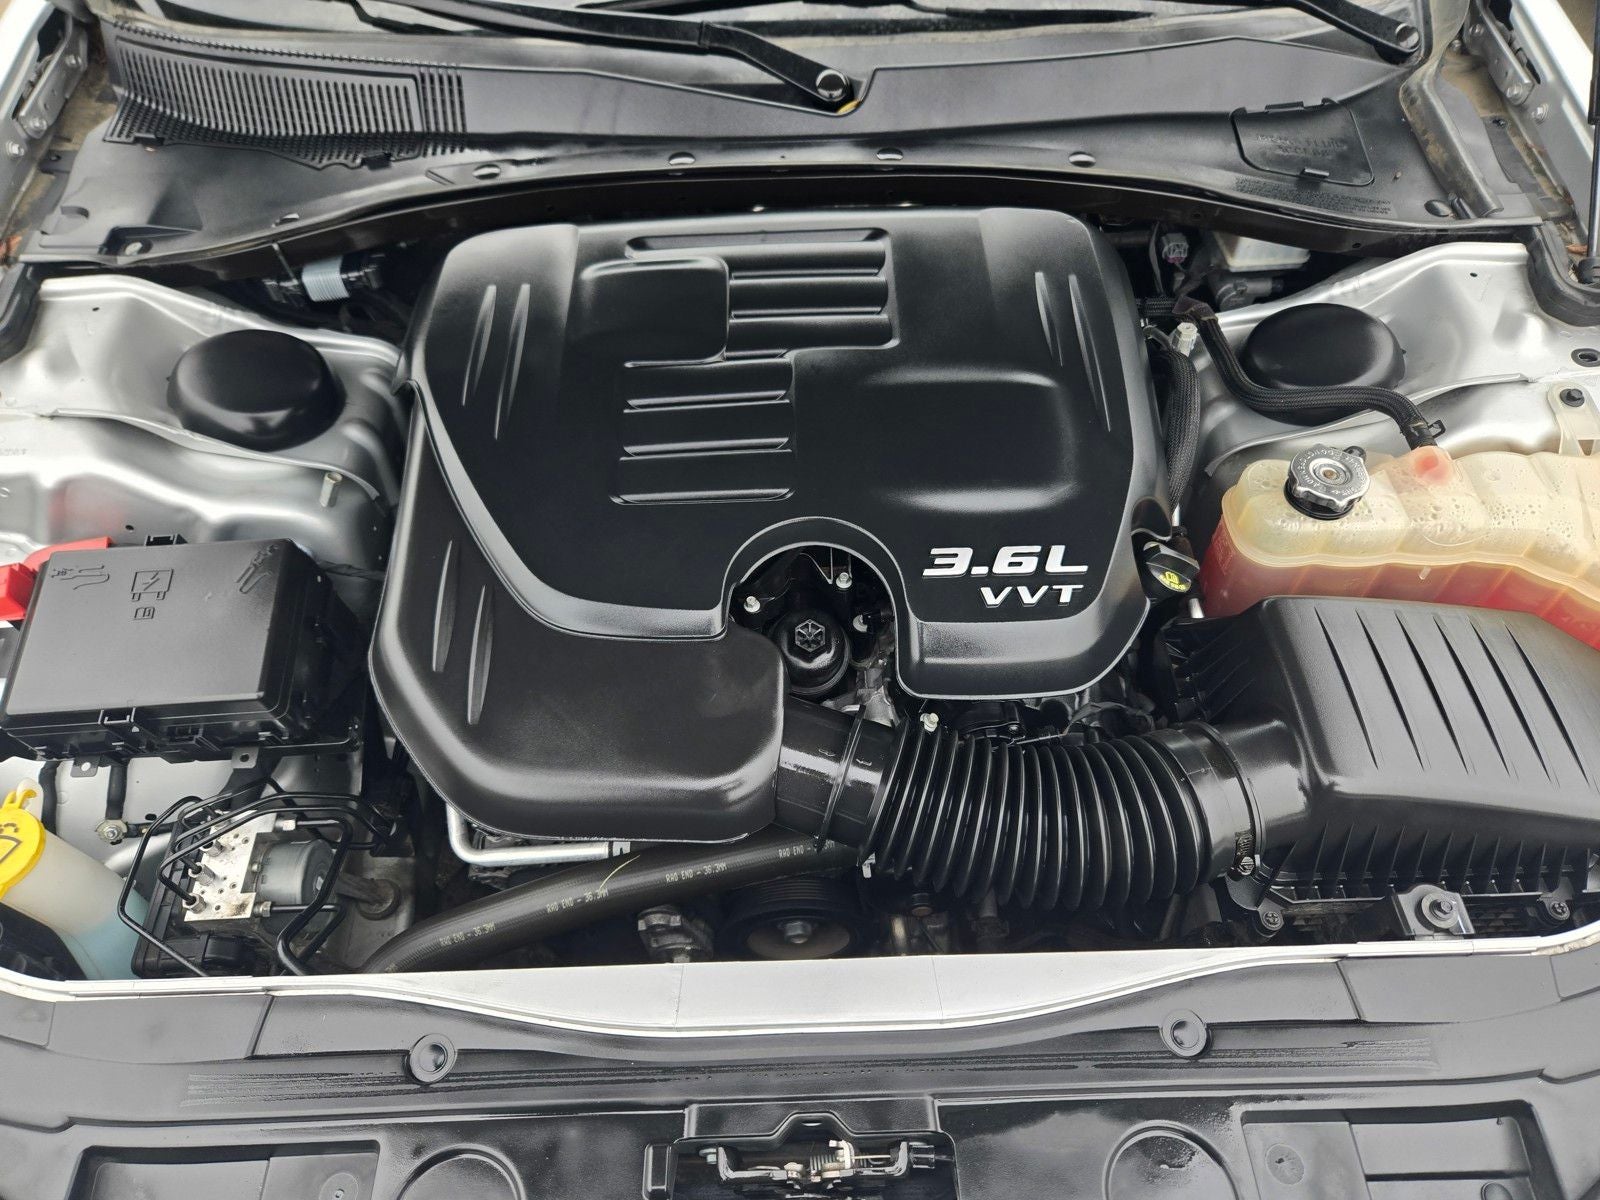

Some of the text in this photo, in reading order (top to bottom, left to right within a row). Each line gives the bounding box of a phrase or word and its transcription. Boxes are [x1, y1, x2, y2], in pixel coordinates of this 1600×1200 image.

[922, 545, 1089, 578] 3.6L
[979, 584, 1085, 608] VVT
[665, 872, 679, 883] RAD
[680, 868, 694, 880] END
